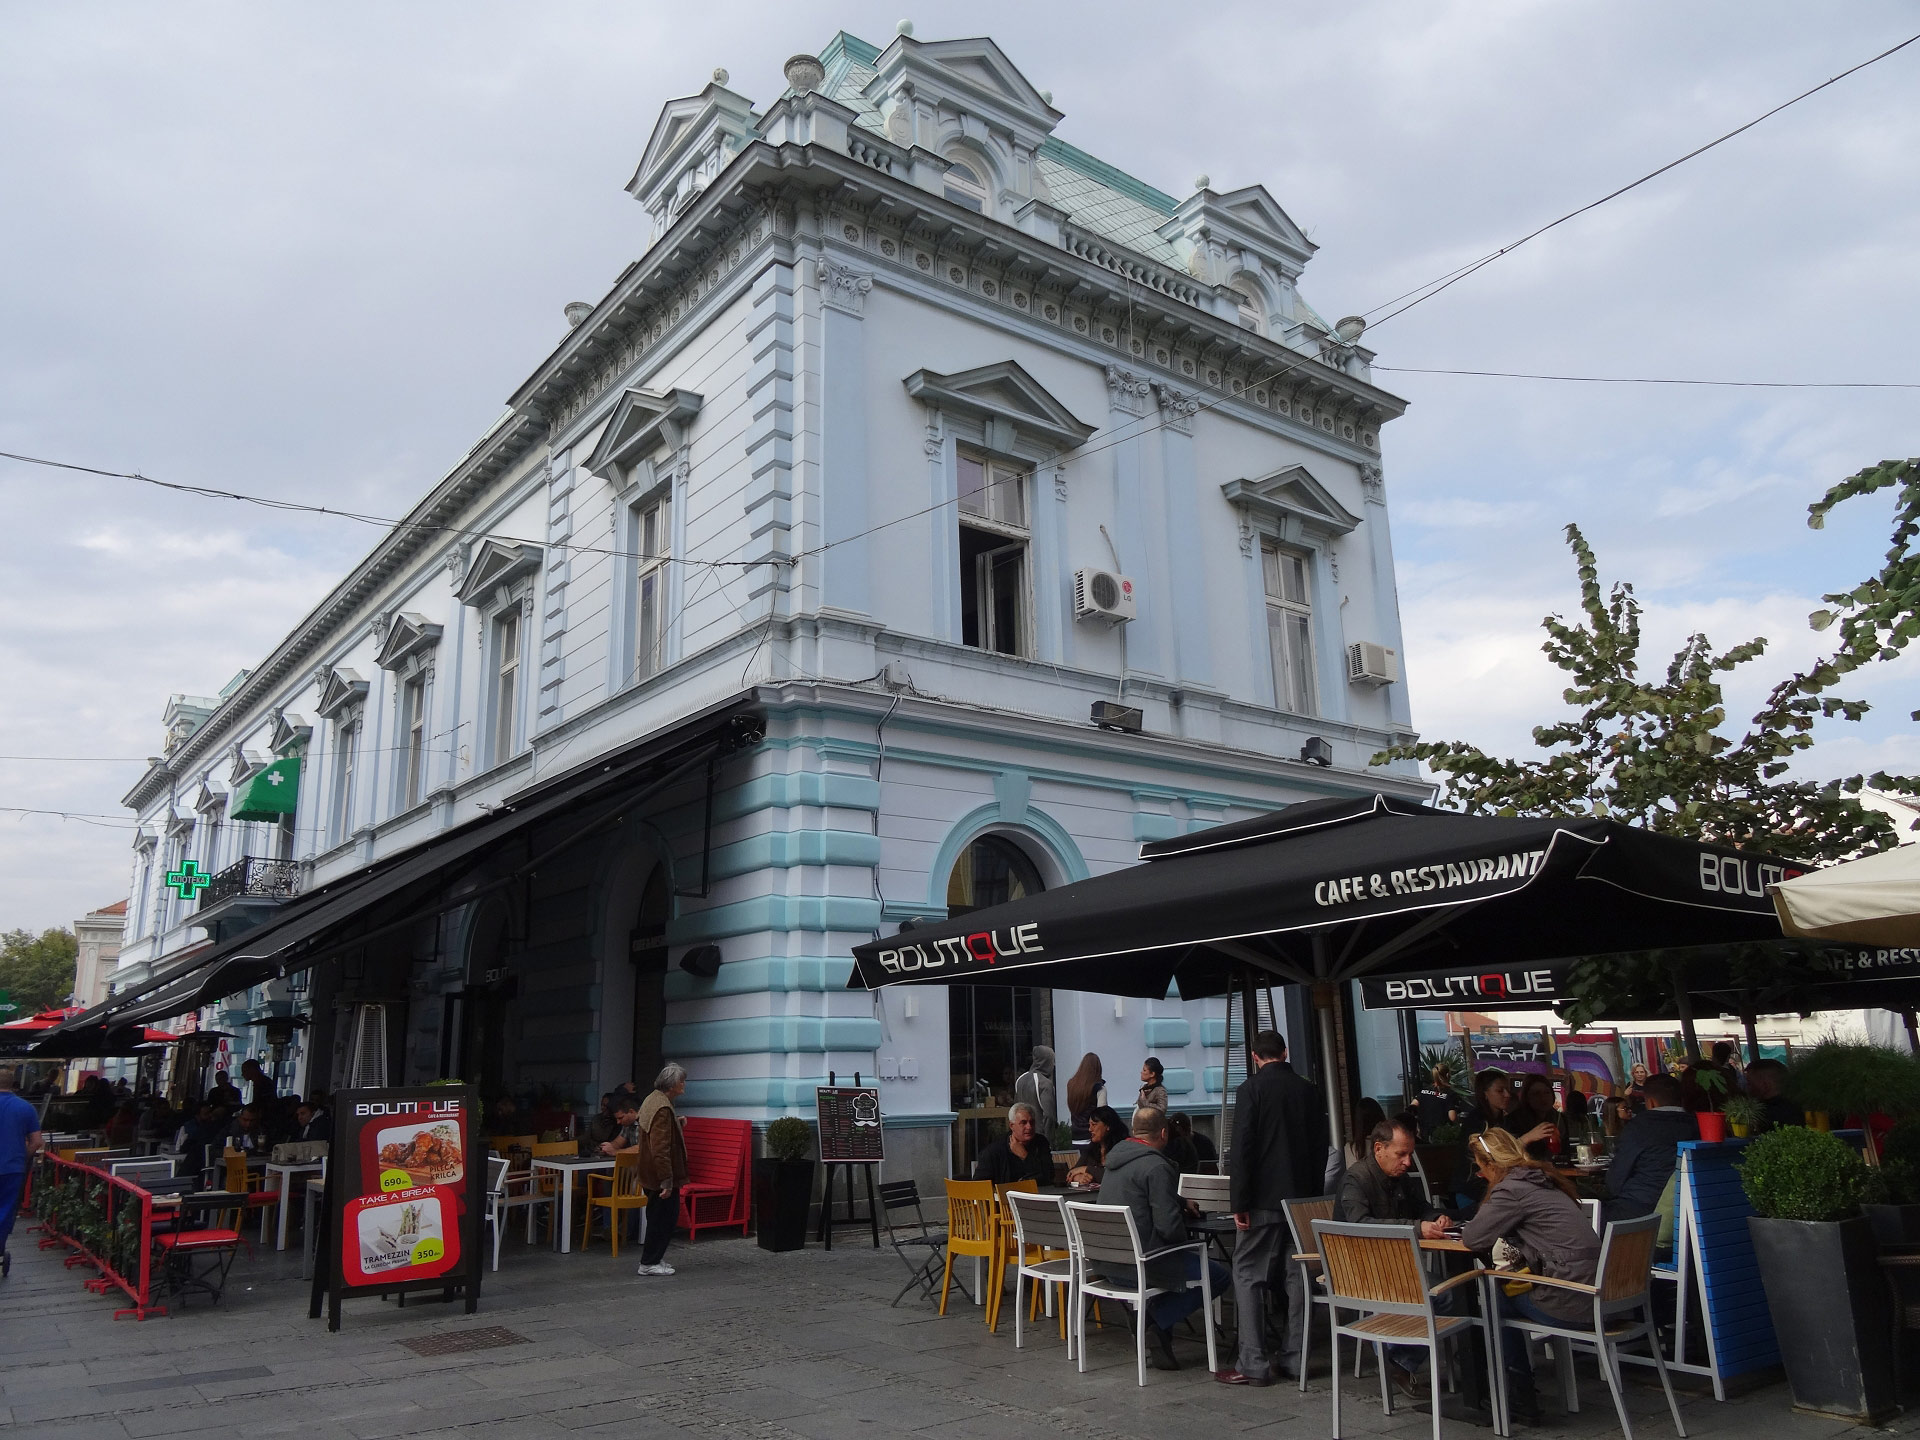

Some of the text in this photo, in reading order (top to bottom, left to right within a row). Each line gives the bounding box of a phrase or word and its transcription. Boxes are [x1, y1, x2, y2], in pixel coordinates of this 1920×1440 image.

[1315, 851, 1544, 905] CAFE & RESTAURANT
[879, 923, 1043, 973] BOUTIQUE
[1858, 950, 1873, 968] &
[1386, 970, 1555, 999] BOUTIQUE
[355, 1100, 460, 1115] BOUTIQUE
[384, 1177, 401, 1187] 690
[359, 1194, 387, 1205] TAKE
[401, 1186, 435, 1198] BREAK
[364, 1249, 410, 1264] TRAMEZZIN
[417, 1249, 434, 1259] 350
